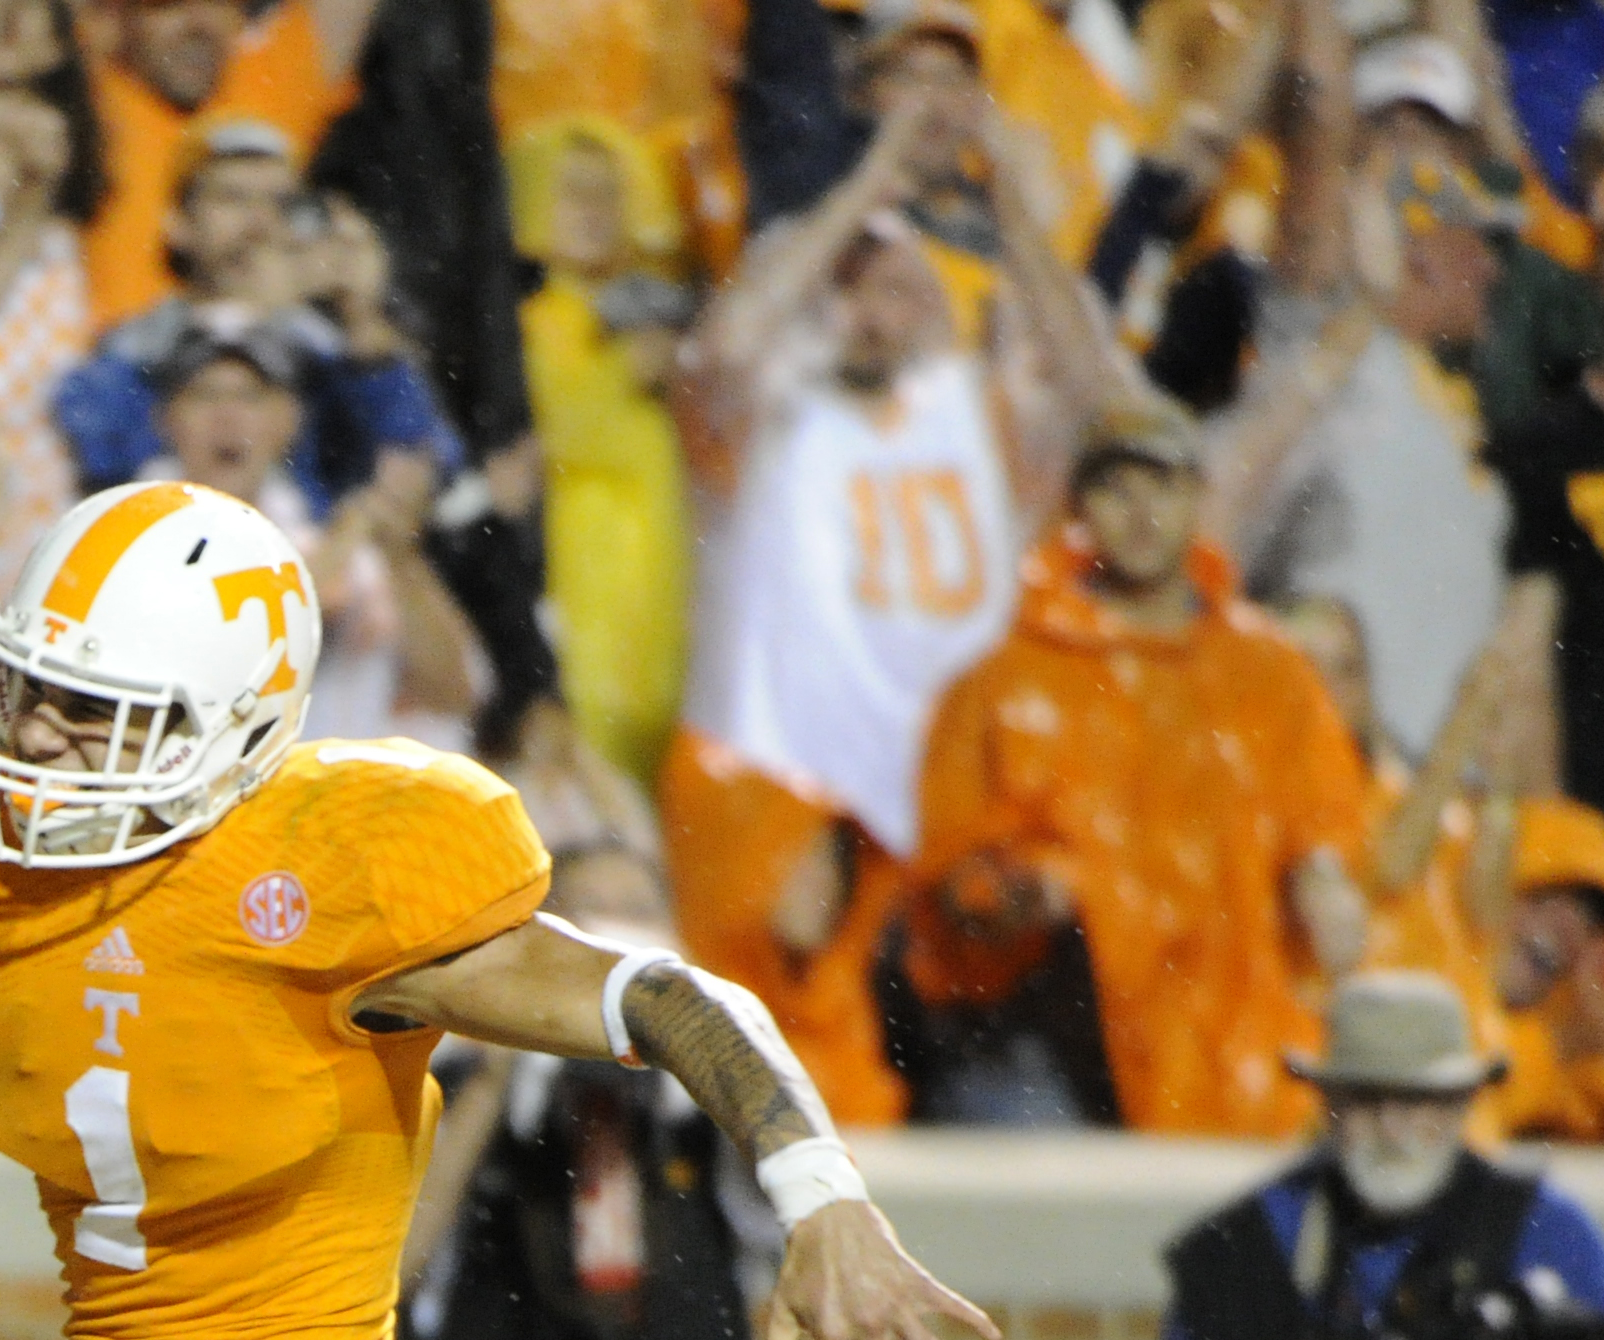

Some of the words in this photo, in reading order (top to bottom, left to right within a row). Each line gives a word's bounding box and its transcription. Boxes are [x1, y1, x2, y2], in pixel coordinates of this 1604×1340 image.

[848, 470, 984, 613] 10
[44, 616, 68, 644] T
[212, 562, 308, 697] T
[246, 875, 305, 940] SEC
[82, 955, 146, 977] adidas
[83, 986, 141, 1058] T
[64, 1065, 148, 1271] 1
